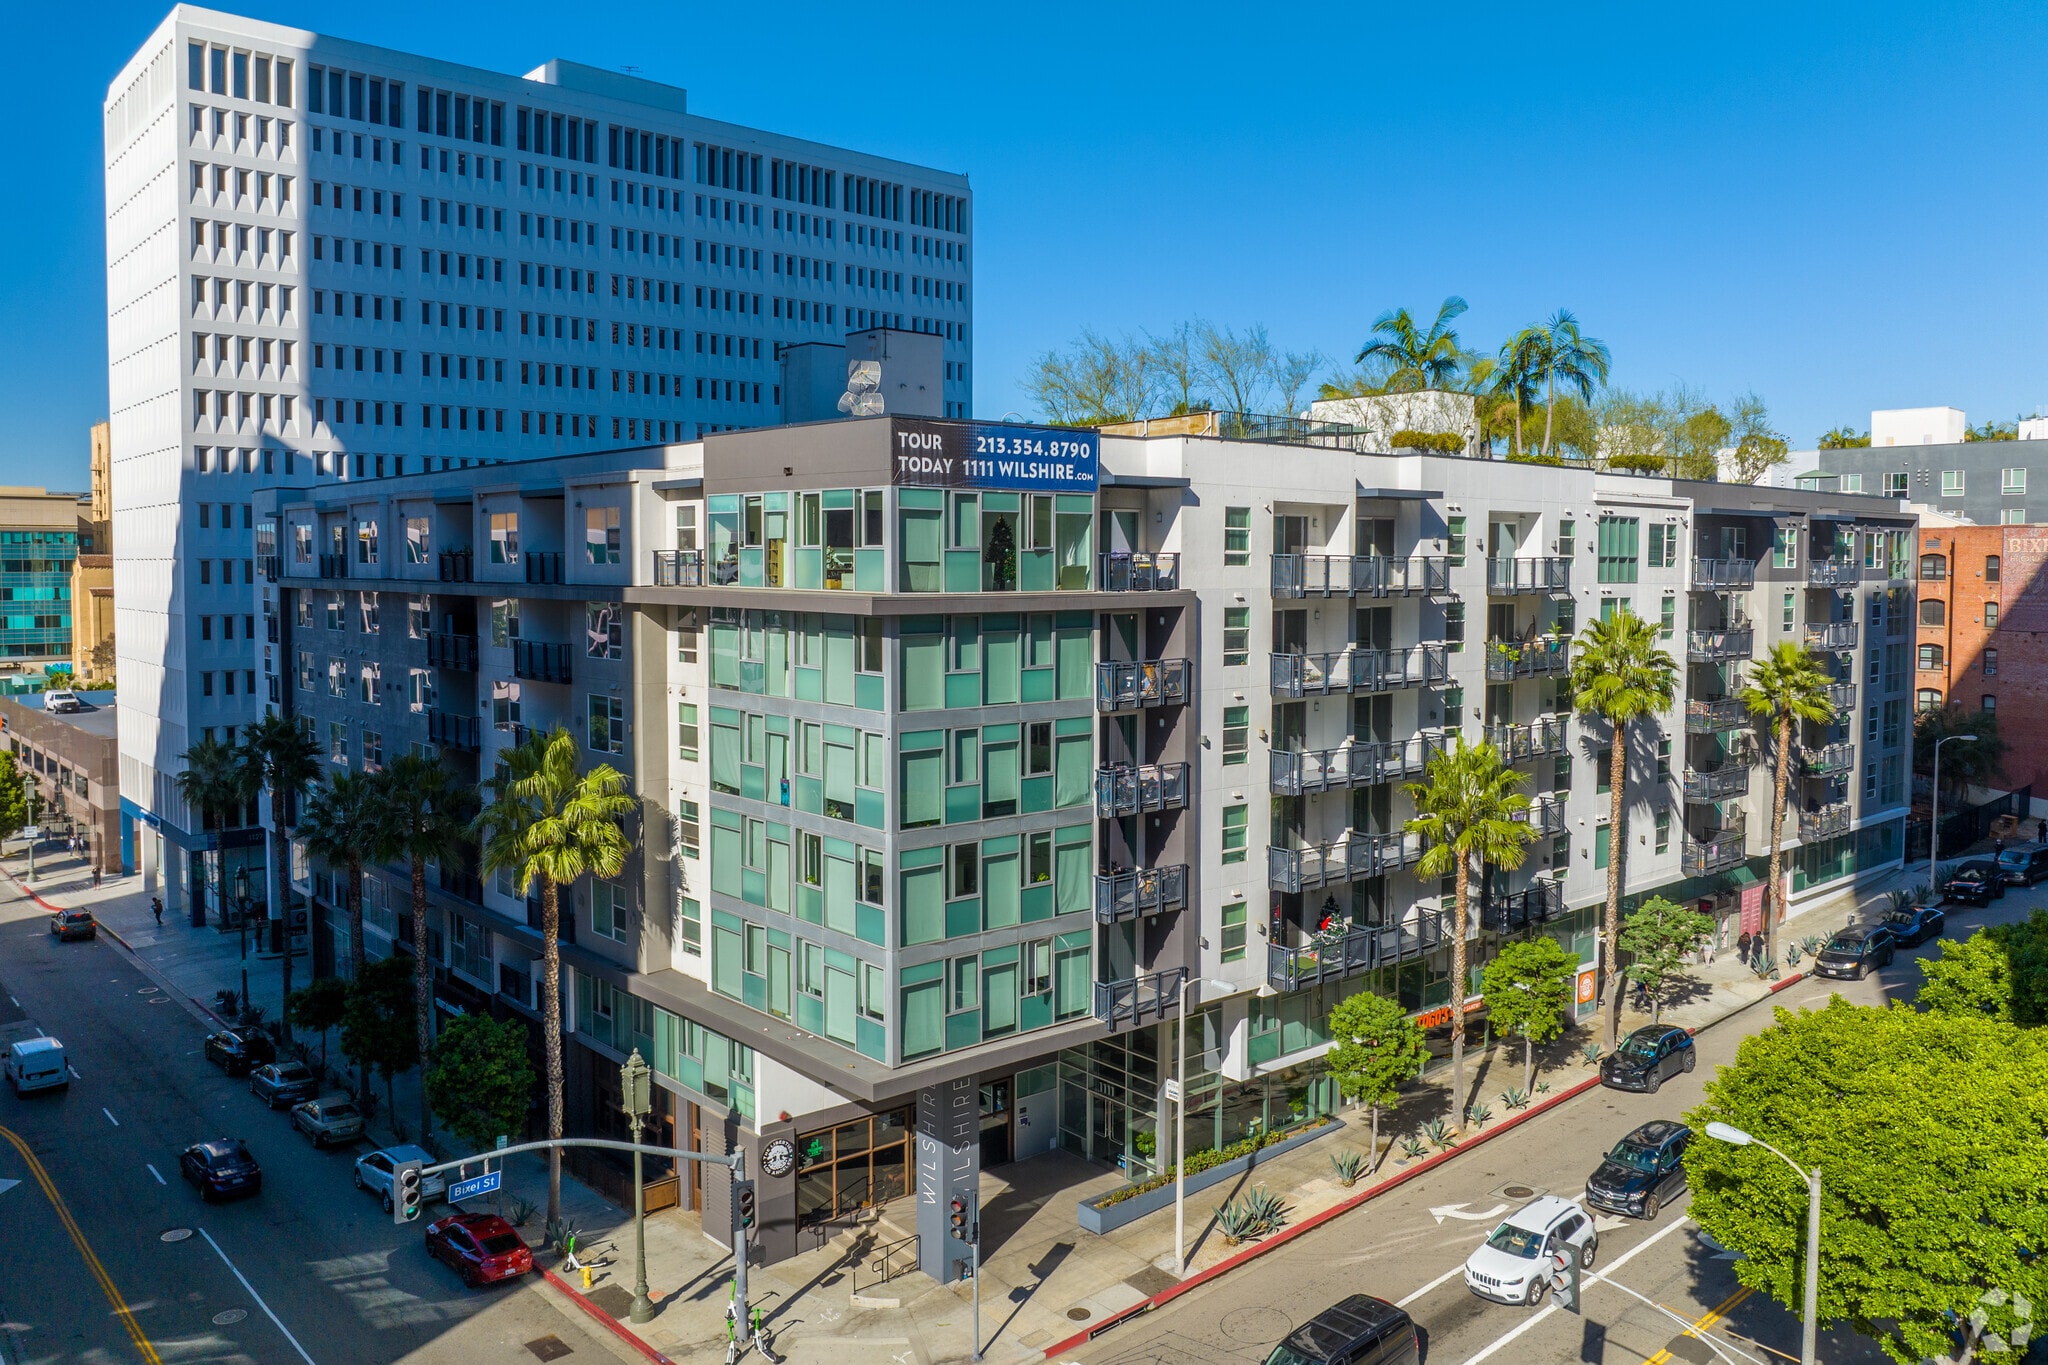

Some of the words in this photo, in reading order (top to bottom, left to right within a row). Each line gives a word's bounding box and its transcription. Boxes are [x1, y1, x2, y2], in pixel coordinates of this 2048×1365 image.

[898, 432, 942, 450] TOUR
[977, 436, 1090, 459] 213.354.8790
[898, 455, 953, 474] TODAY
[963, 459, 994, 477] 1111
[998, 461, 1094, 481] WILSHIRE.COM
[1417, 1007, 1449, 1028] TOGO'S
[952, 1078, 970, 1191] ILSHIRE
[454, 1182, 480, 1197] Bixel
[483, 1177, 495, 1188] St
